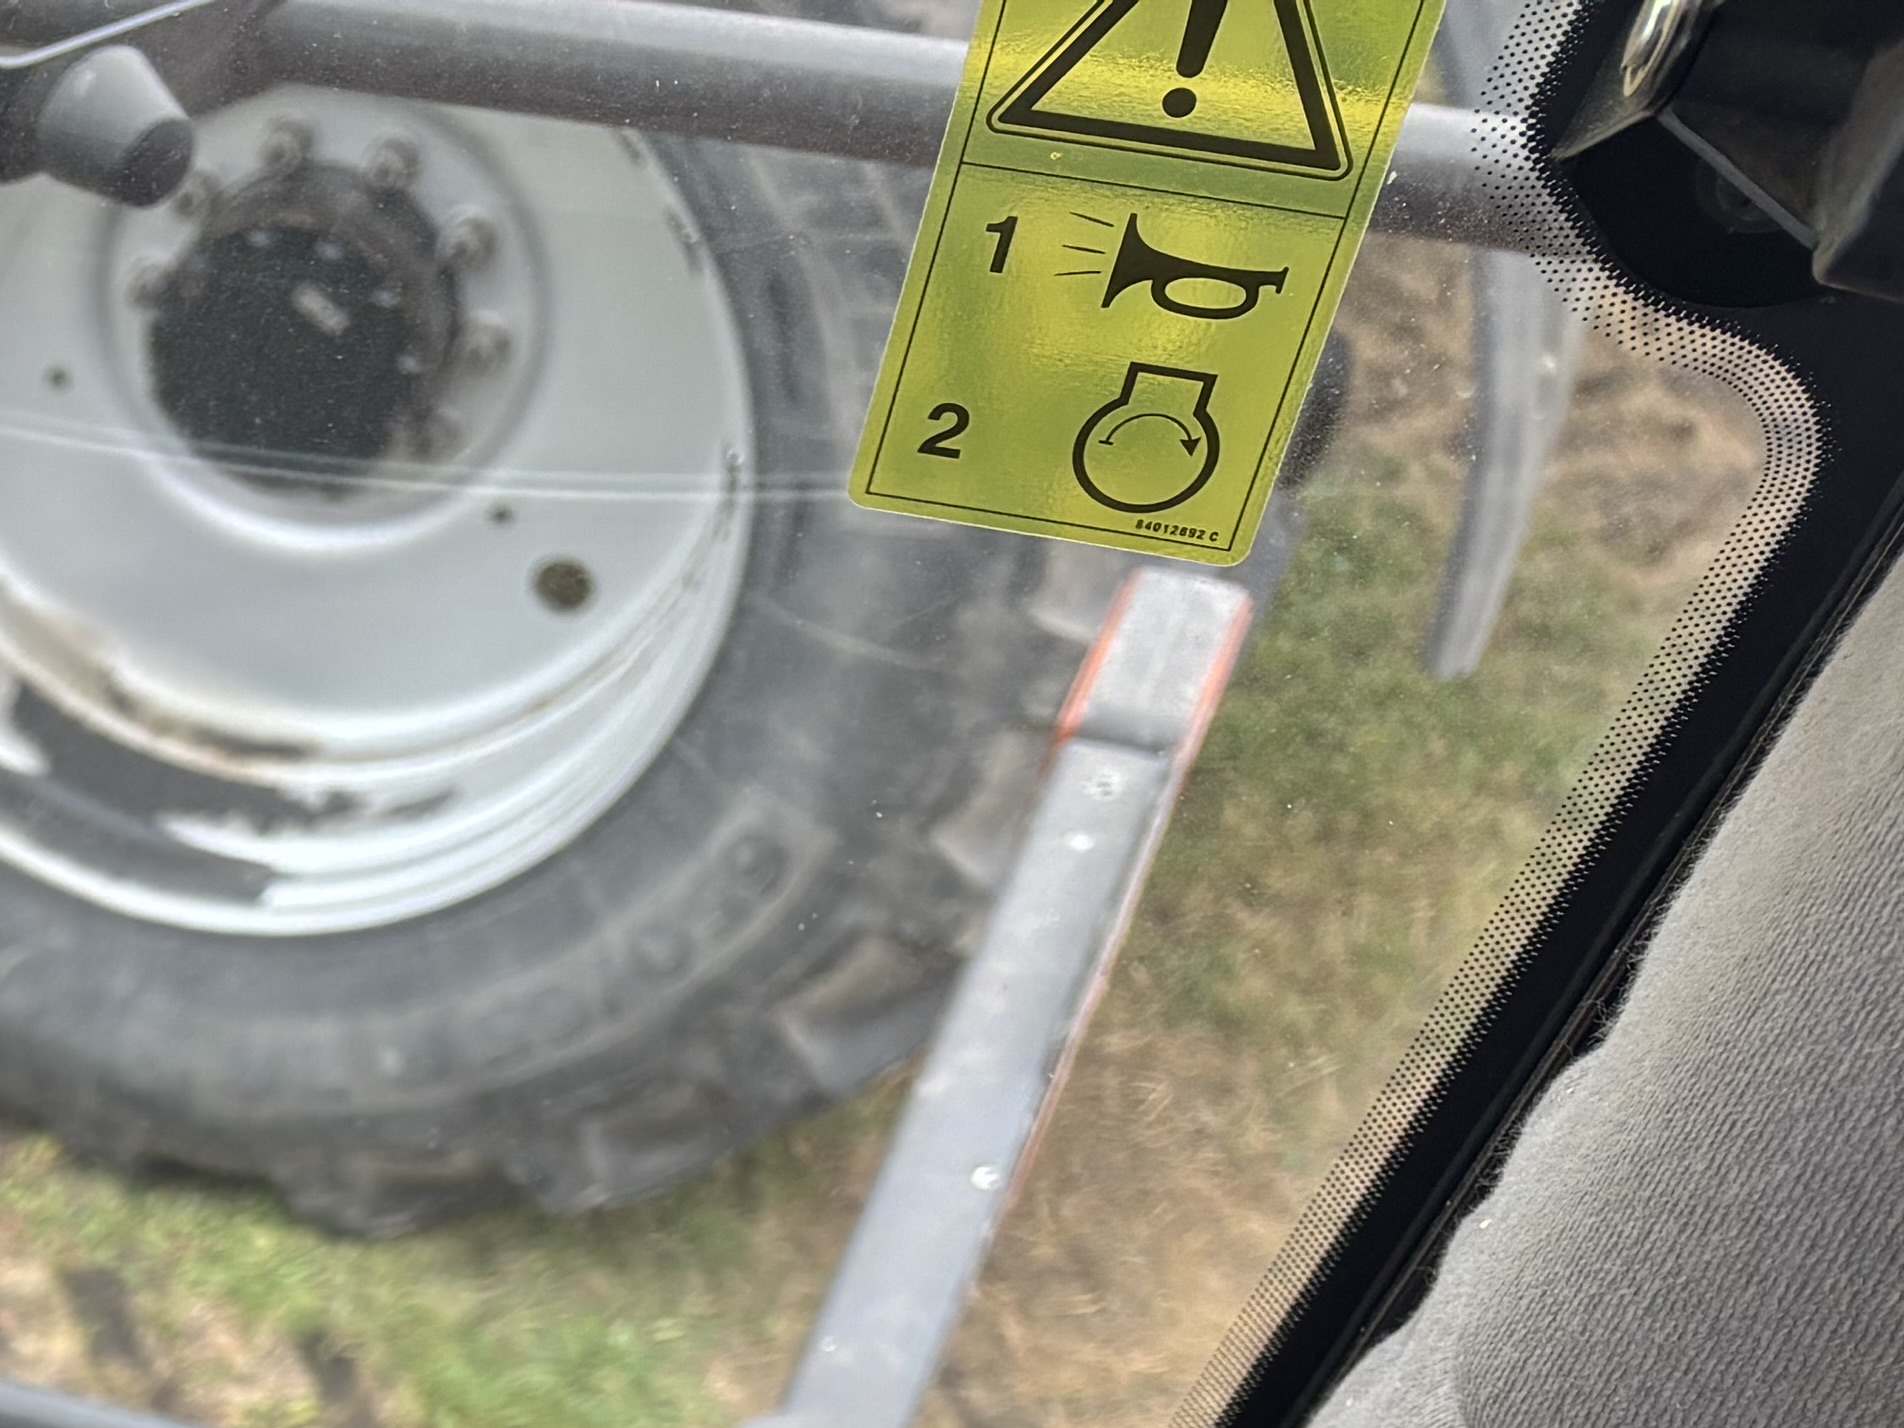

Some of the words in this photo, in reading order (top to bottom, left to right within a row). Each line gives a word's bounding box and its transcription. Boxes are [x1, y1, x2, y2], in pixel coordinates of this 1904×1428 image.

[985, 215, 1020, 275] 1
[916, 402, 971, 460] 2
[1208, 531, 1220, 543] C
